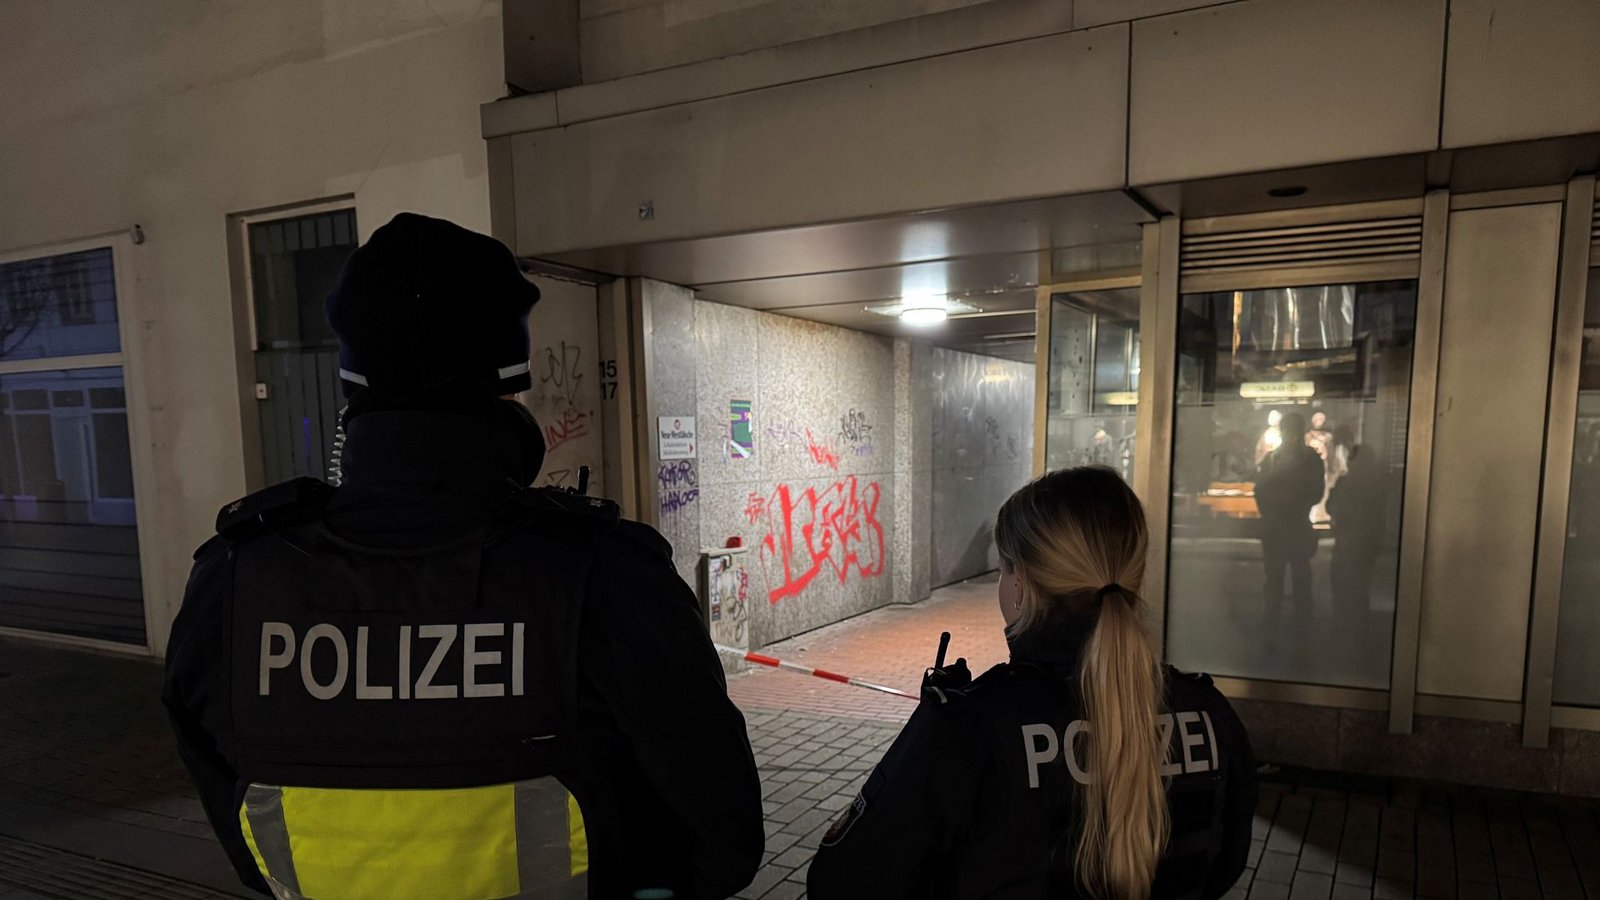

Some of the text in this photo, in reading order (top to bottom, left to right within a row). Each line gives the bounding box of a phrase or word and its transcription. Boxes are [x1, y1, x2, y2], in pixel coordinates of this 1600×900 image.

[599, 359, 617, 378] 15
[601, 381, 618, 400] 17
[259, 621, 525, 700] POLIZEI
[1021, 710, 1219, 789] POZEI
